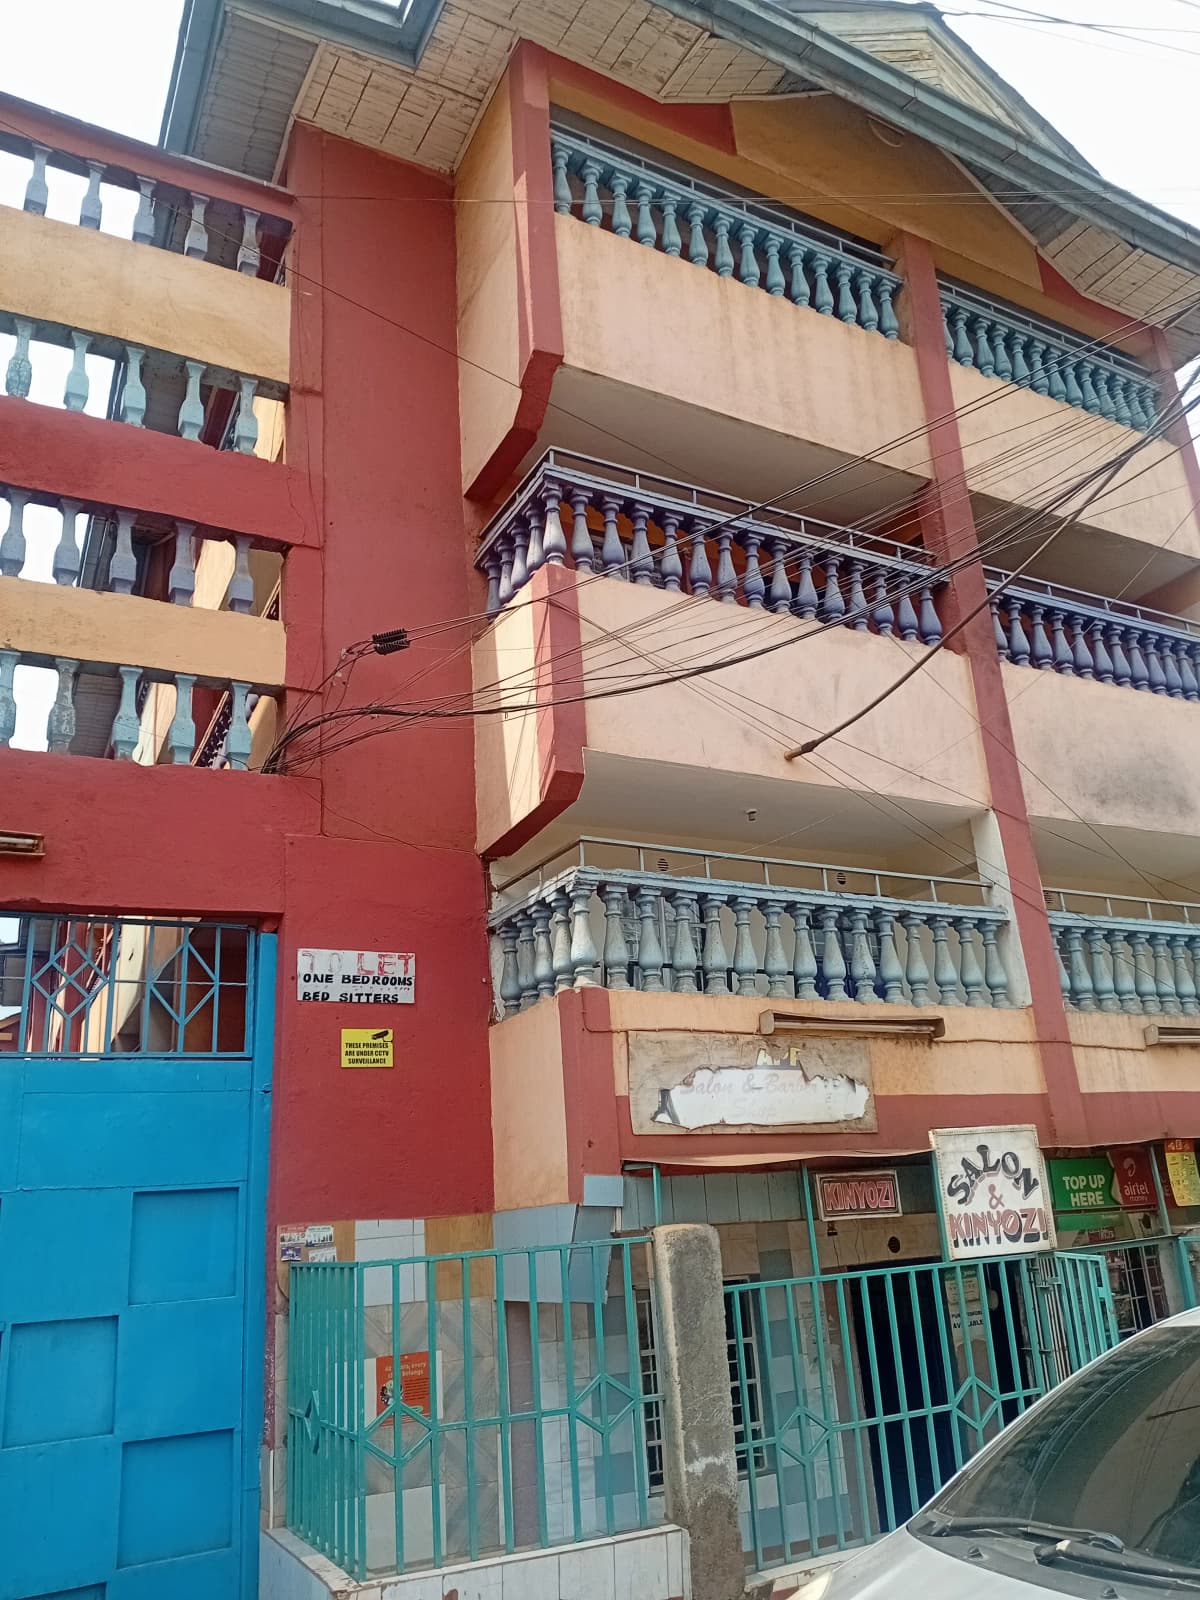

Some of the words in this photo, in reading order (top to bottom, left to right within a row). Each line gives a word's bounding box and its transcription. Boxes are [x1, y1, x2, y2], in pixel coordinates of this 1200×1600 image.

[357, 953, 414, 976] LET
[303, 973, 334, 984] ONE
[342, 974, 413, 986] BEDROOMS
[302, 991, 330, 1002] BED
[339, 992, 399, 1004] SITTERS
[947, 1143, 1040, 1206] SALON
[1062, 1175, 1087, 1191] TOP
[1088, 1174, 1106, 1189] UP
[823, 1180, 896, 1211] KINYOZI
[988, 1183, 1005, 1209] &
[1124, 1181, 1150, 1196] airtel
[1070, 1191, 1105, 1207] HERE
[948, 1207, 1049, 1247] KINYOZI
